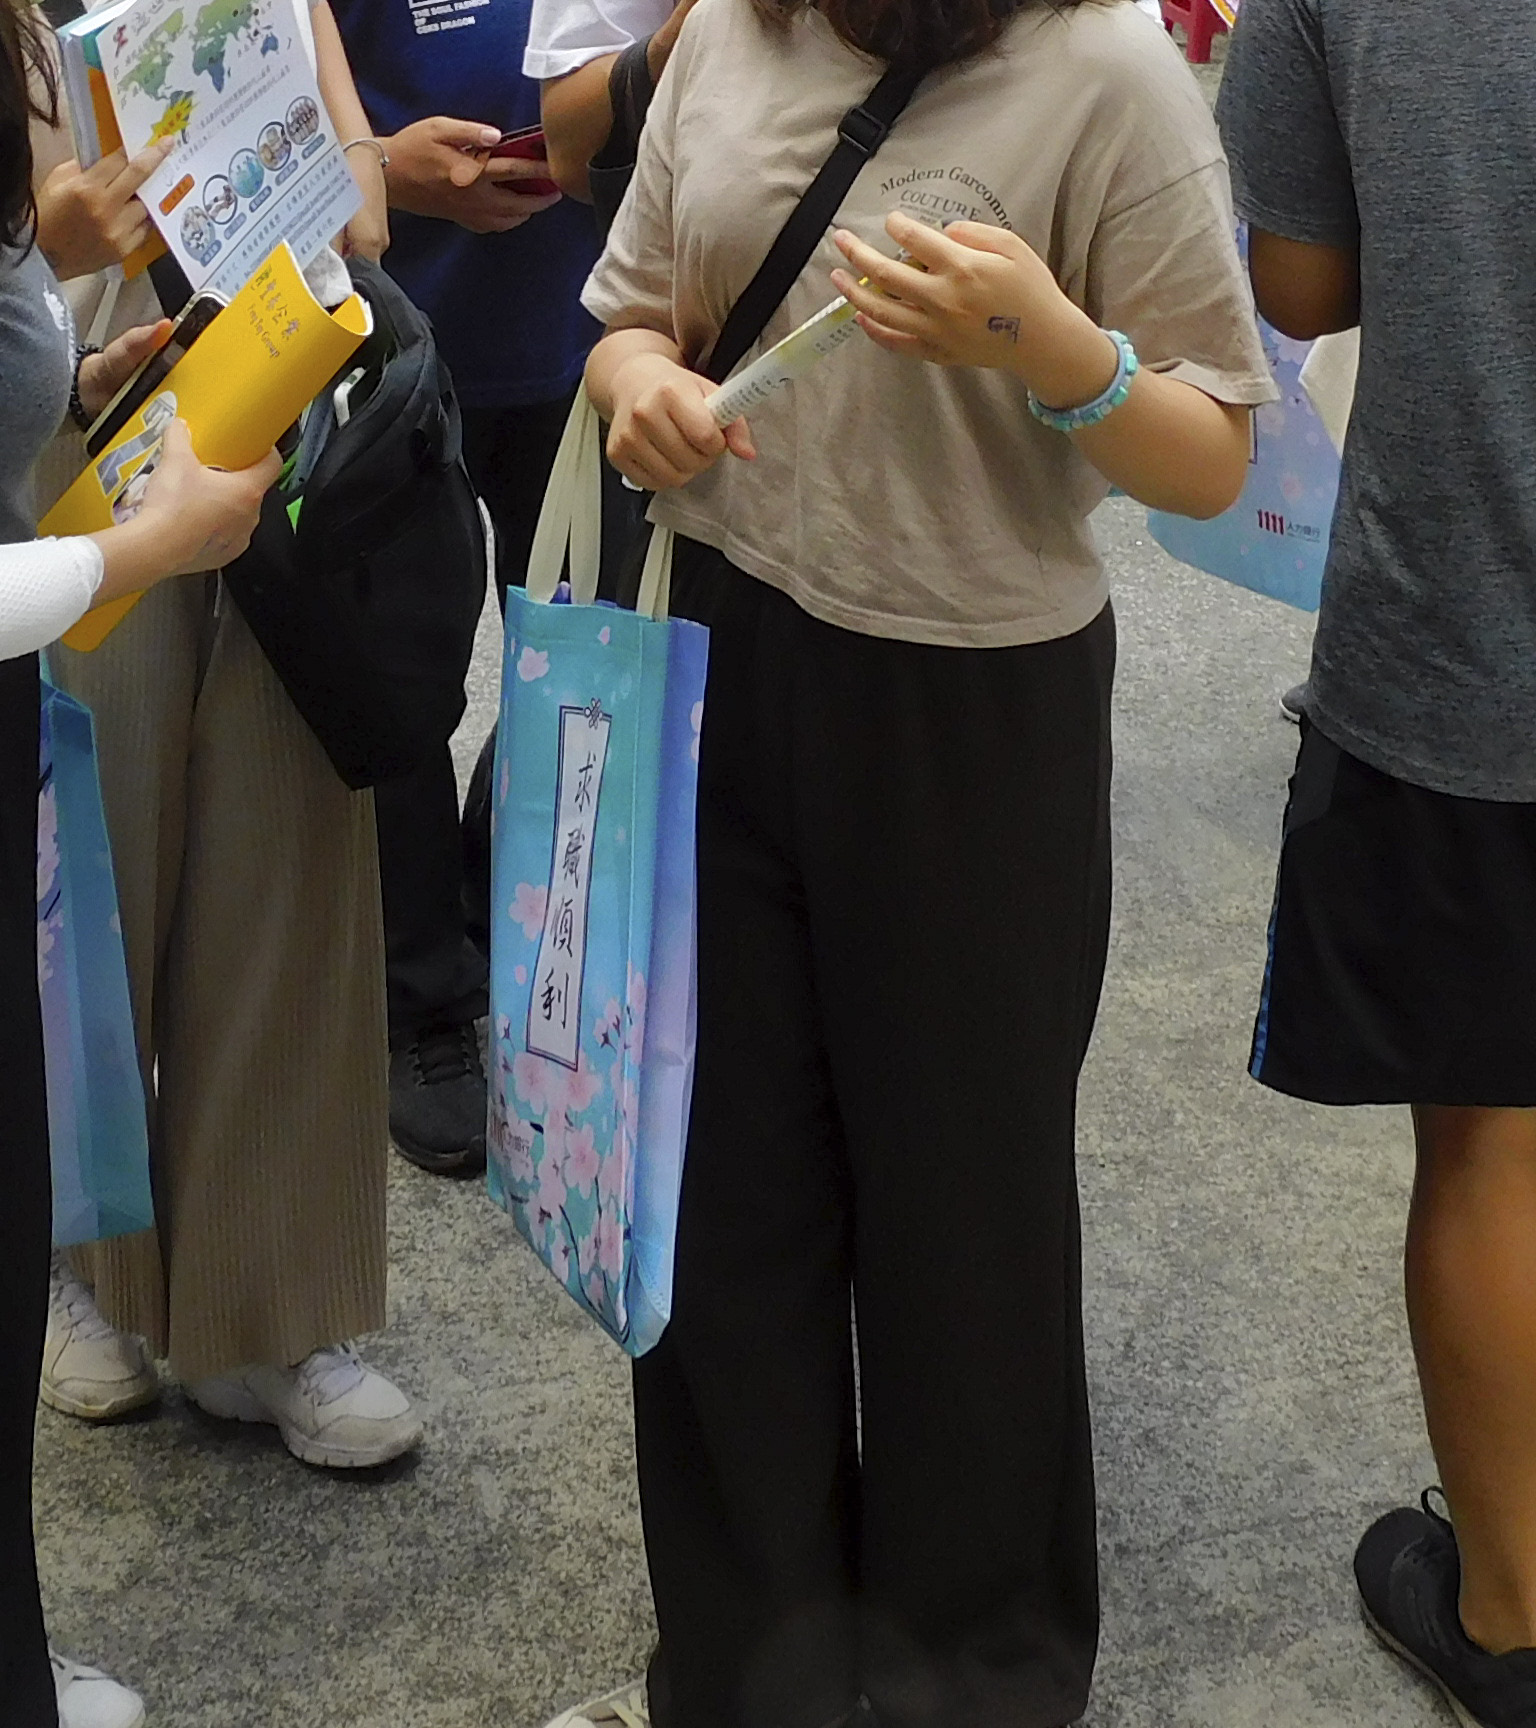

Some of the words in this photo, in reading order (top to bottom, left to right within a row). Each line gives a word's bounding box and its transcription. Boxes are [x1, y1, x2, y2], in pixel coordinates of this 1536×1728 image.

[880, 168, 945, 197] Modern
[900, 189, 982, 222] COUTURE
[540, 750, 597, 1030] 求職順利
